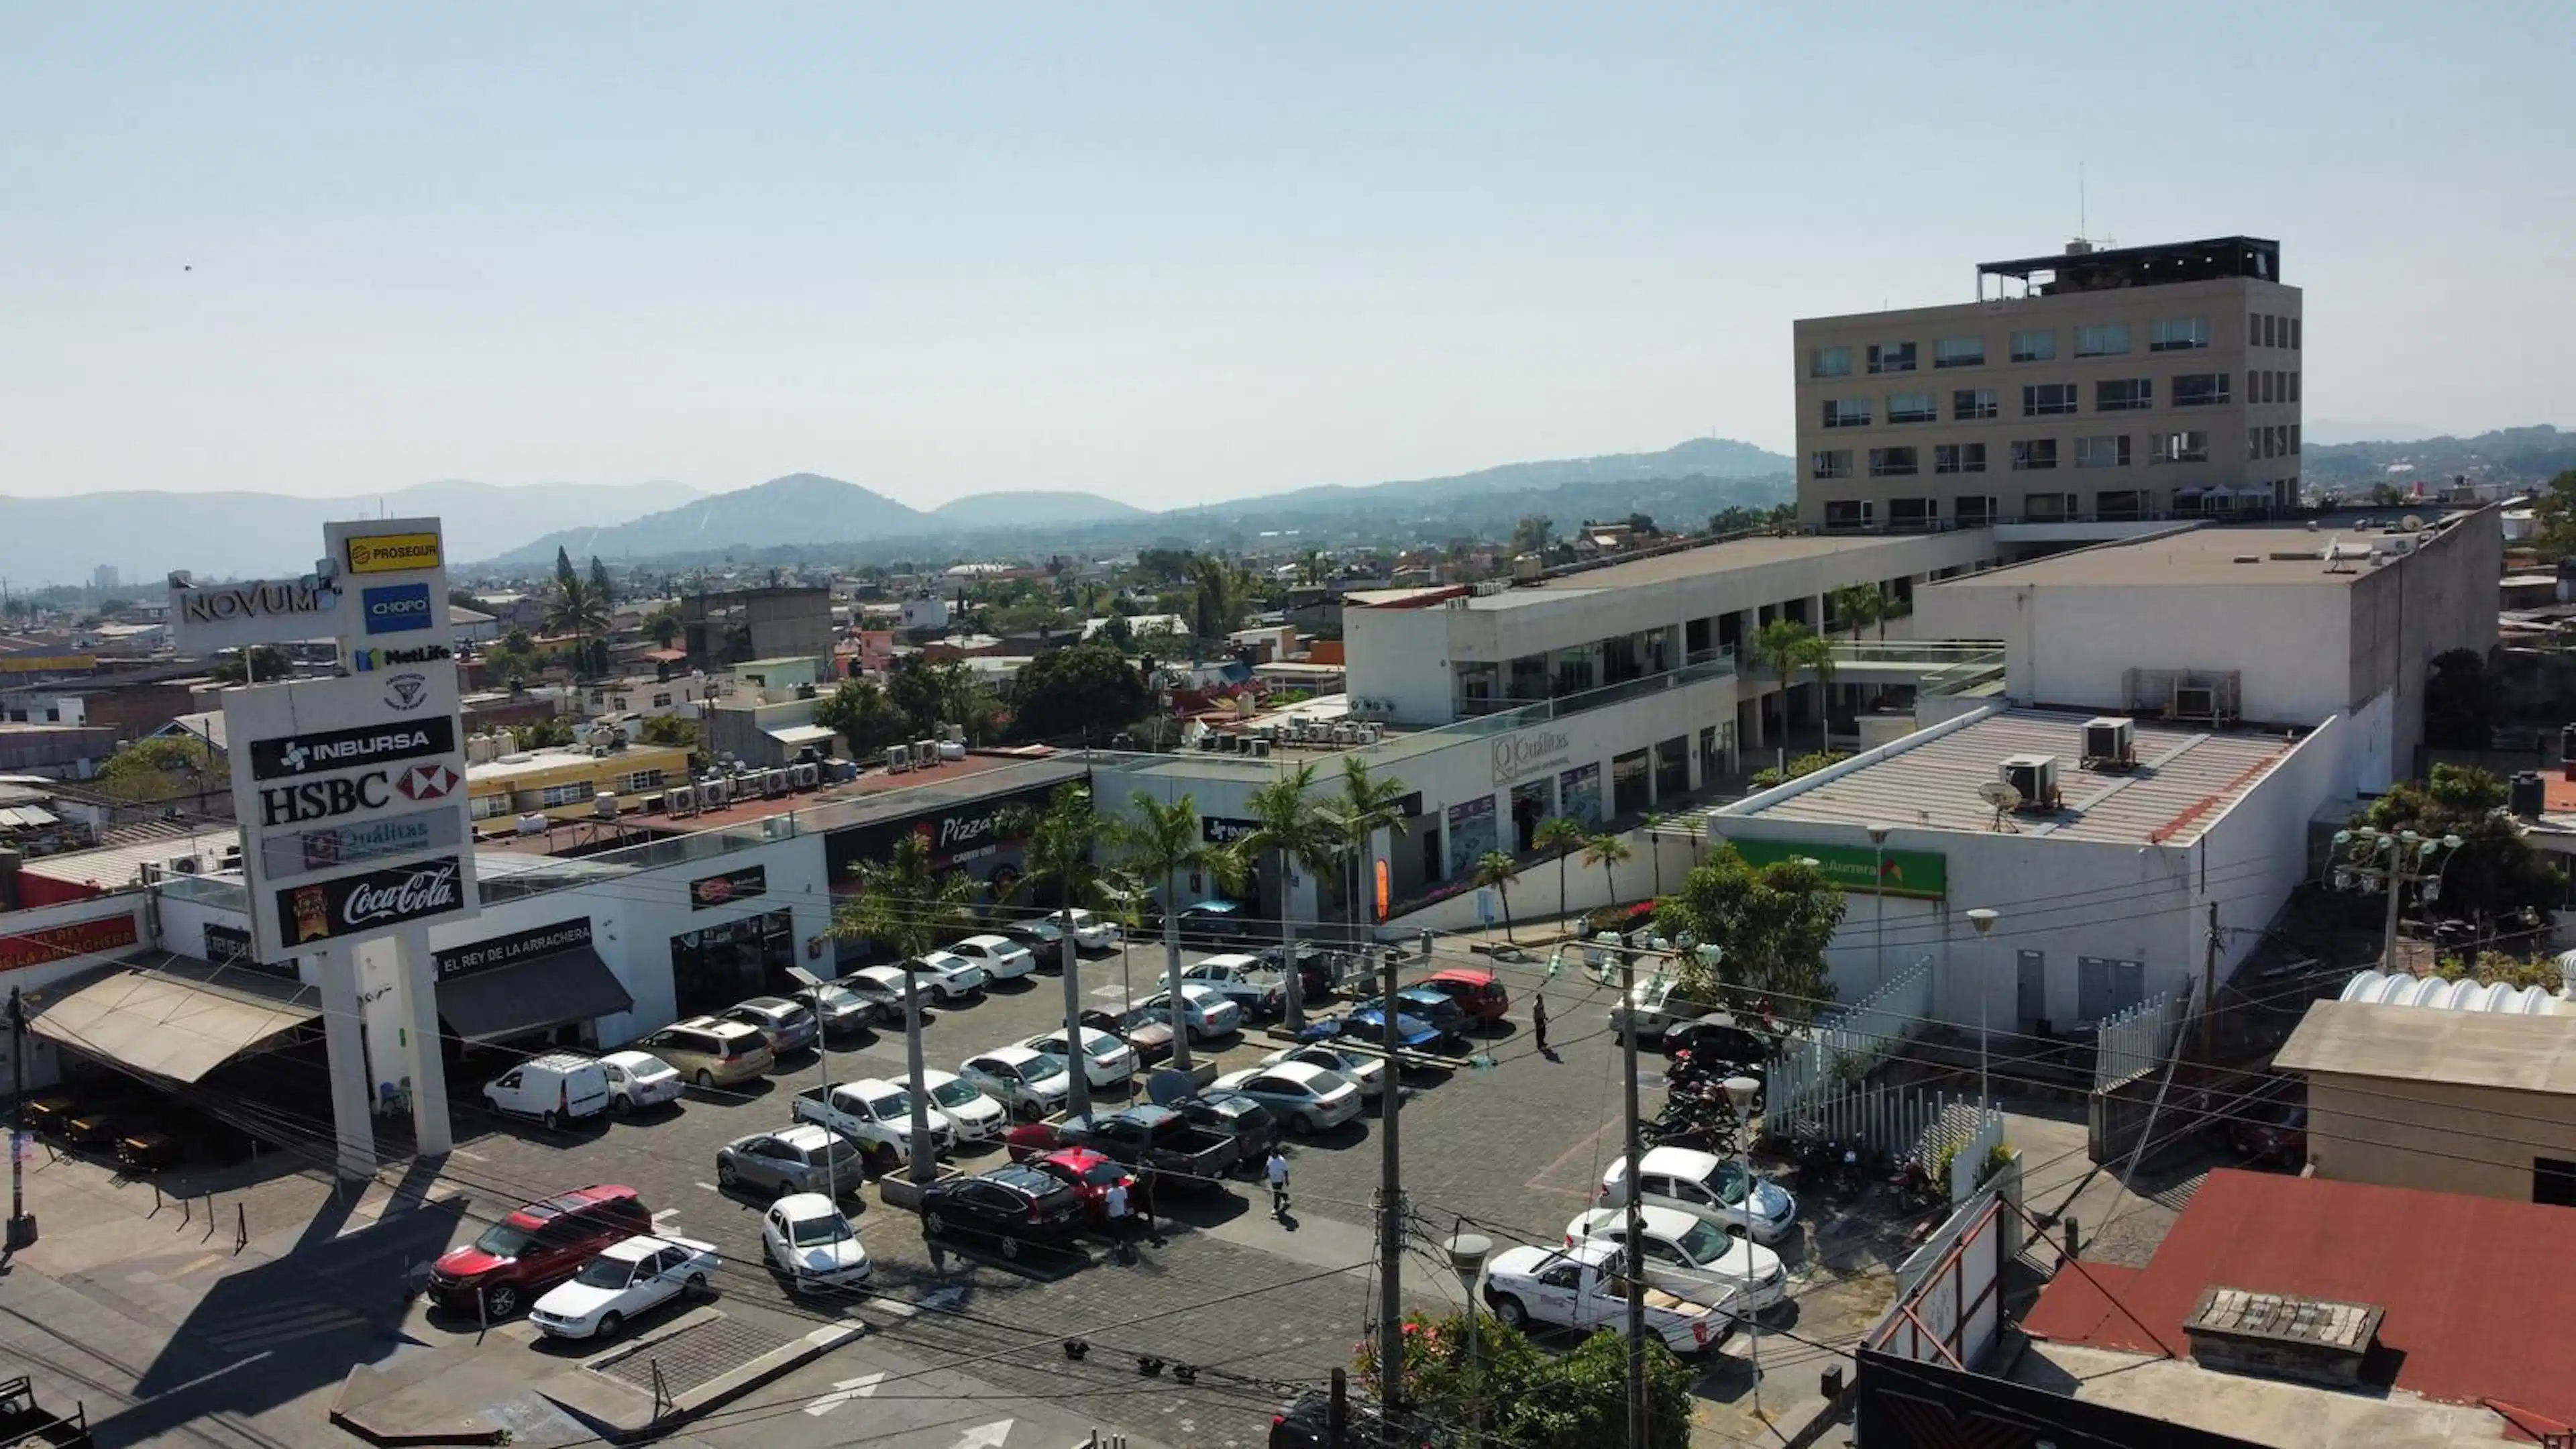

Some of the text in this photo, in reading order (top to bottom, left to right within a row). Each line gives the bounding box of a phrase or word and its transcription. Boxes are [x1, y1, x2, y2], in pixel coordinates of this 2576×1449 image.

[373, 545, 436, 559] PROSEGUR
[182, 582, 317, 623] NOVUM
[313, 731, 430, 761] INBURSA
[258, 771, 391, 826] HSBC
[941, 816, 991, 849] Pizza
[443, 926, 591, 973] EL REY DE LA ARRACHERA
